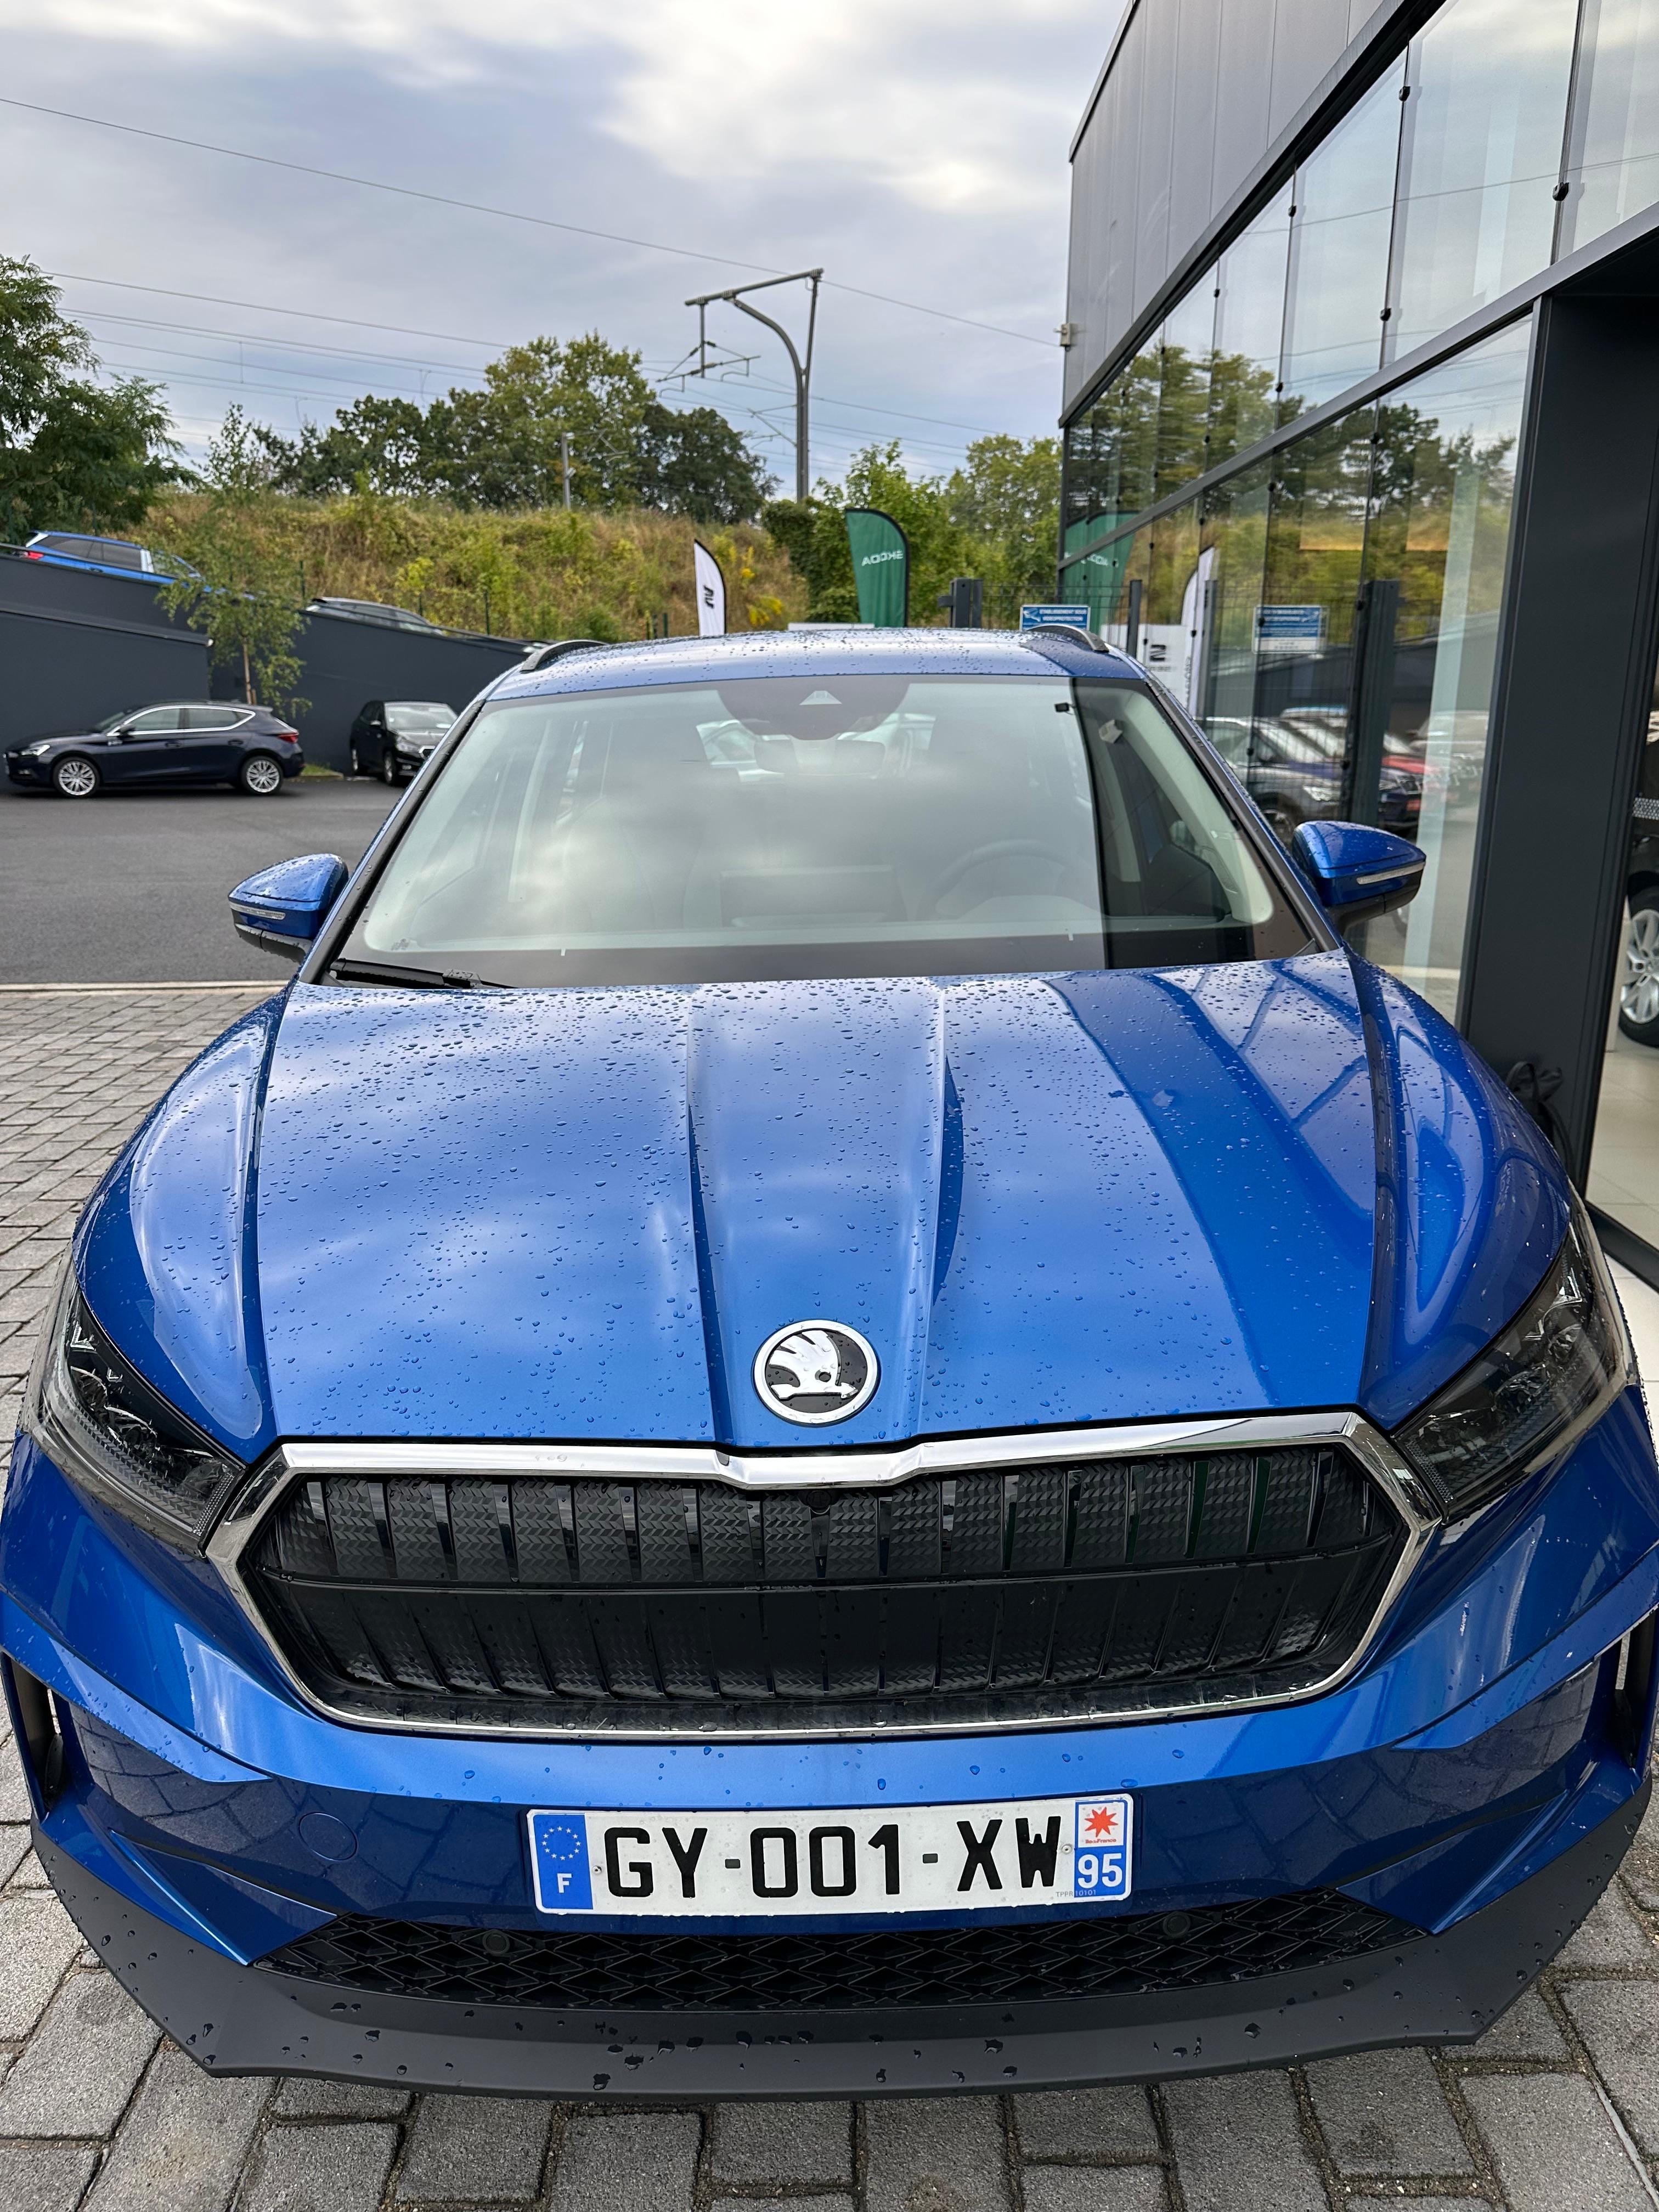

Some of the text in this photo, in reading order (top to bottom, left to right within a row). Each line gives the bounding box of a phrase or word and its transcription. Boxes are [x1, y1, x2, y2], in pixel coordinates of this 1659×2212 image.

[604, 1816, 1061, 1898] GY-001-XW
[1078, 1853, 1122, 1888] 95
[557, 1873, 572, 1893] F
